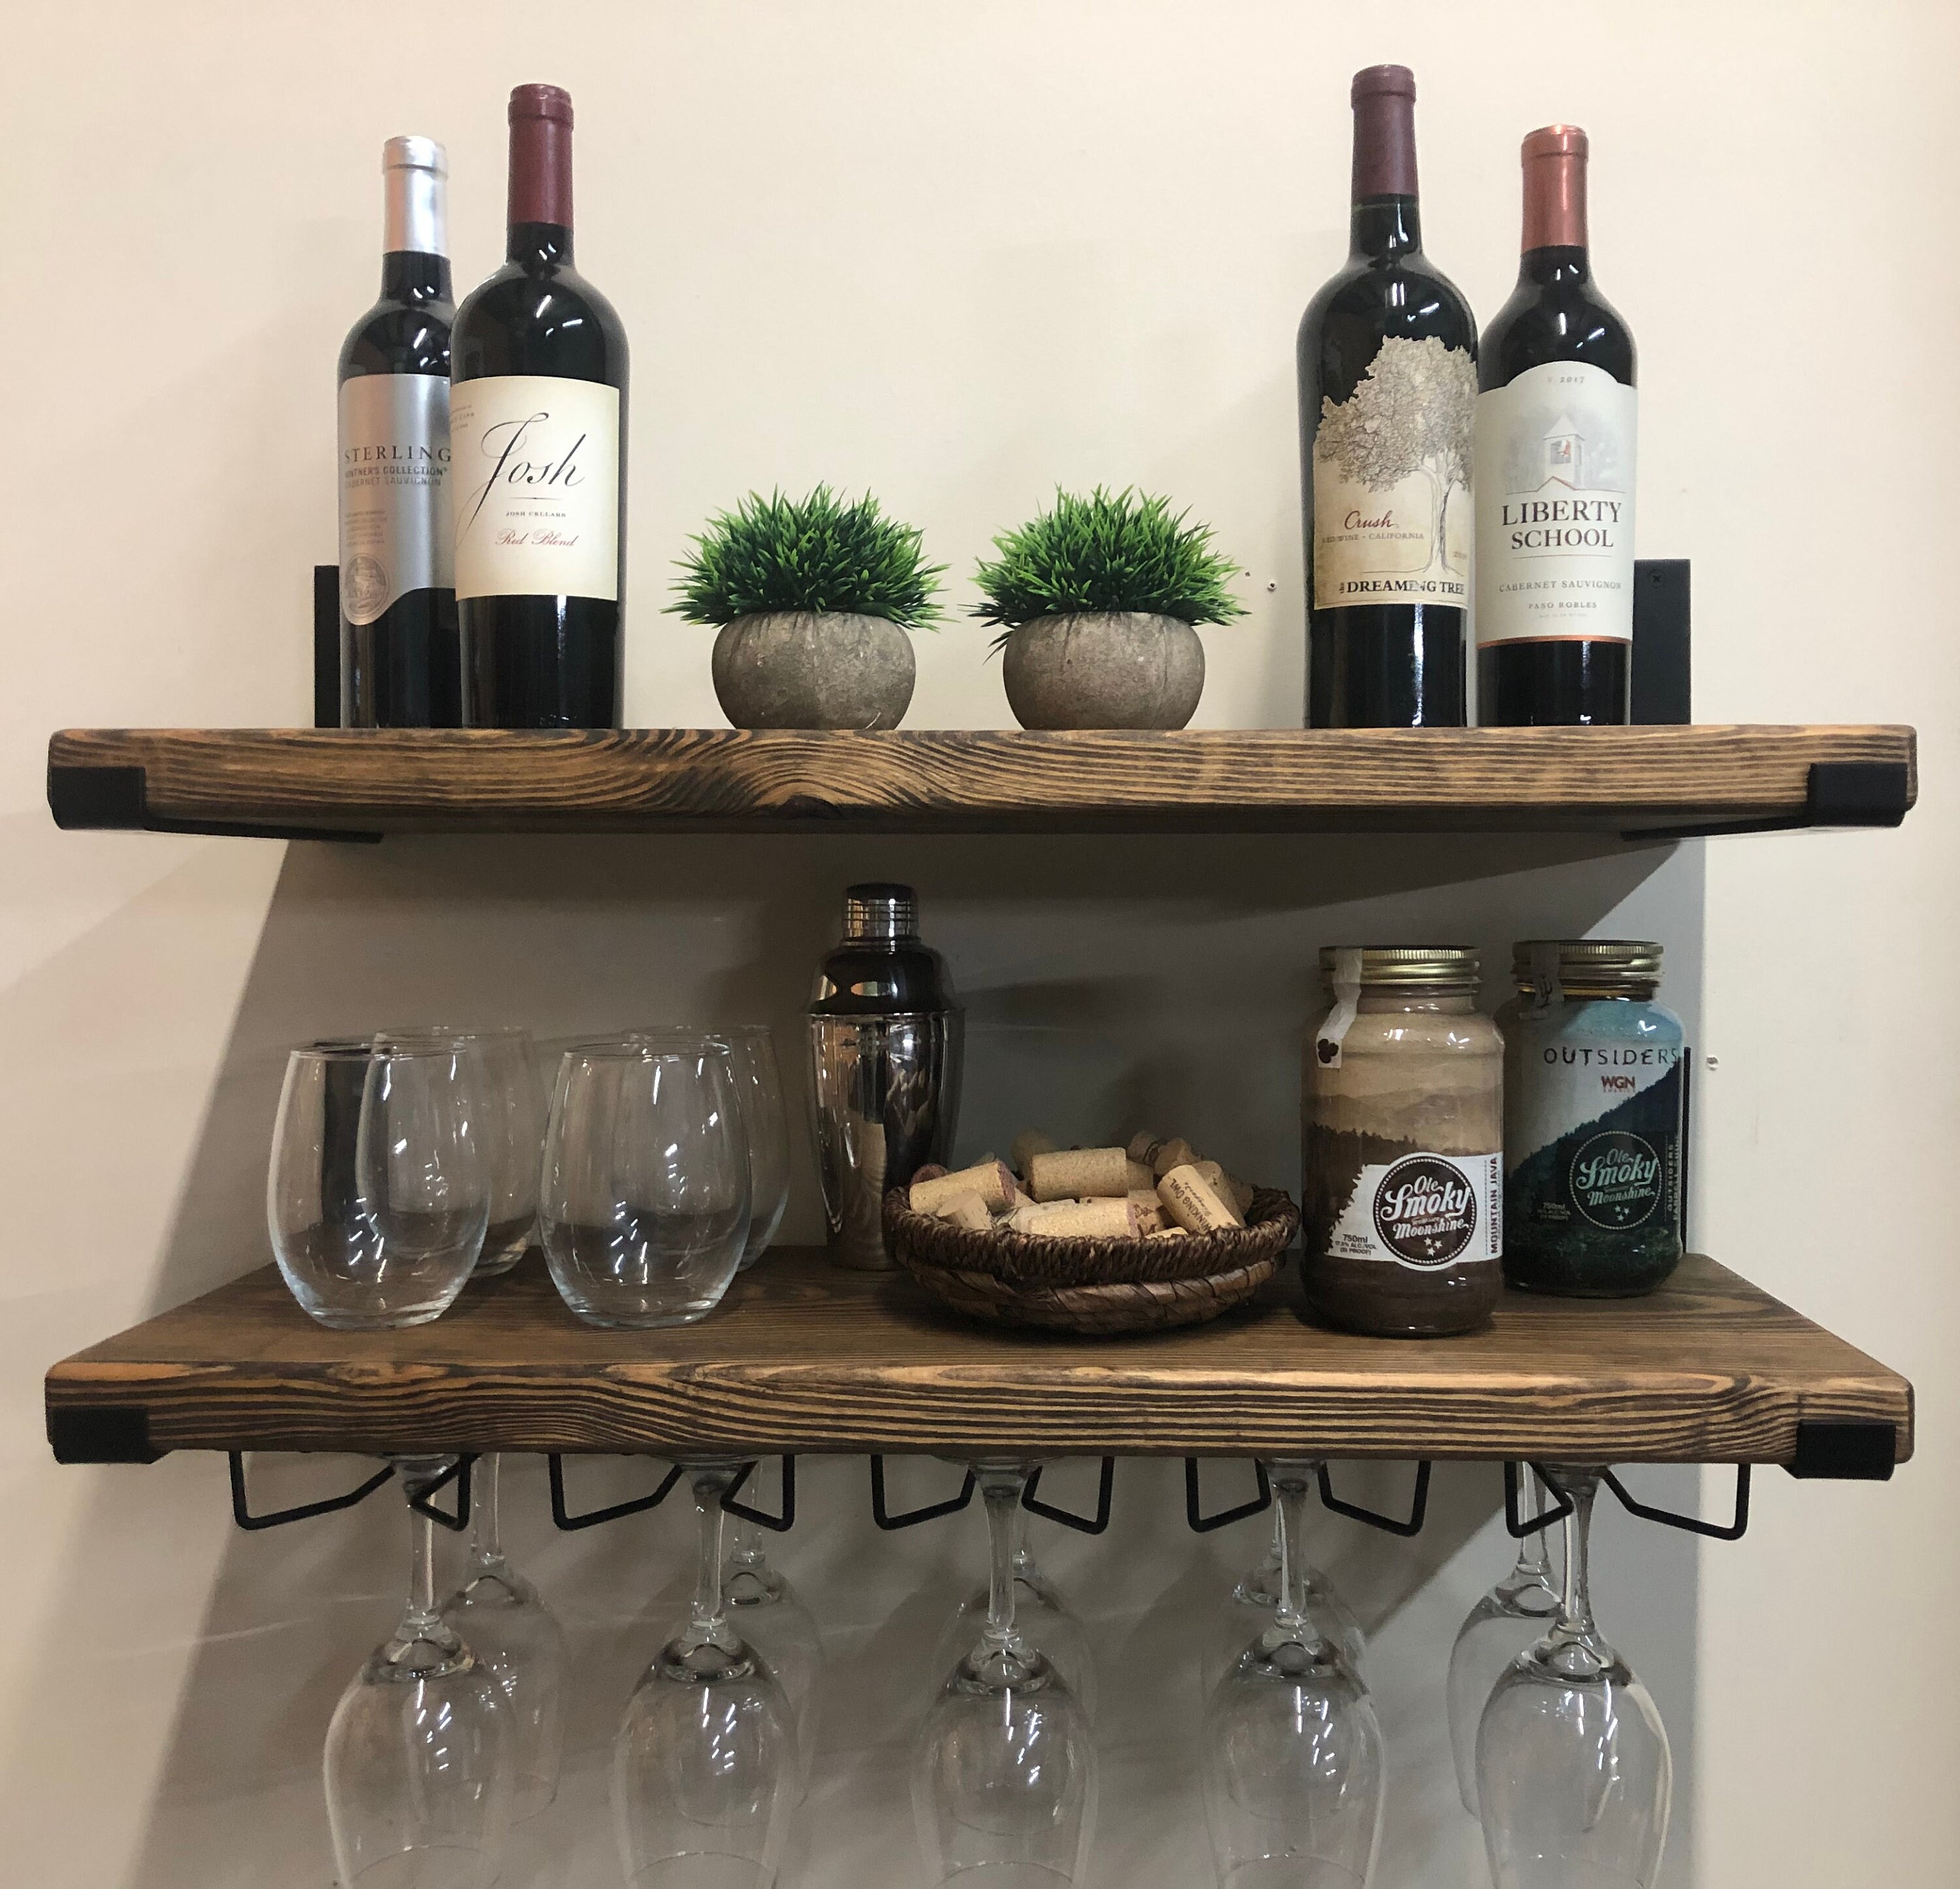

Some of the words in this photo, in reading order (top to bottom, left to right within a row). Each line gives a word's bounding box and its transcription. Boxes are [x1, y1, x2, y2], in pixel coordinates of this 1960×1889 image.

[344, 445, 451, 464] STERLING
[455, 412, 587, 549] Josh
[1343, 510, 1399, 531] Crush
[1501, 499, 1622, 526] LIBERTY
[495, 527, 529, 546] Red
[531, 528, 579, 547] Blend
[1511, 528, 1614, 550] SCHOOL
[1499, 580, 1558, 593] CABERNET
[1561, 580, 1622, 589] SAUVIGNON
[1528, 601, 1554, 610] PASO
[1543, 1046, 1679, 1066] OUTSIDERS
[1601, 1076, 1635, 1090] WGN
[1606, 1148, 1634, 1165] Ole
[1490, 1157, 1498, 1185] JAVA
[1575, 1153, 1659, 1190] Smoky
[1169, 1178, 1185, 1199] OWL
[1414, 1175, 1444, 1194] Ole
[1380, 1181, 1471, 1221] Smoky
[1587, 1187, 1655, 1206] Moonshine
[1392, 1217, 1469, 1240] Moonshine
[1490, 1189, 1498, 1254] MOUNTAIN
[1343, 1234, 1368, 1243] 750ml
